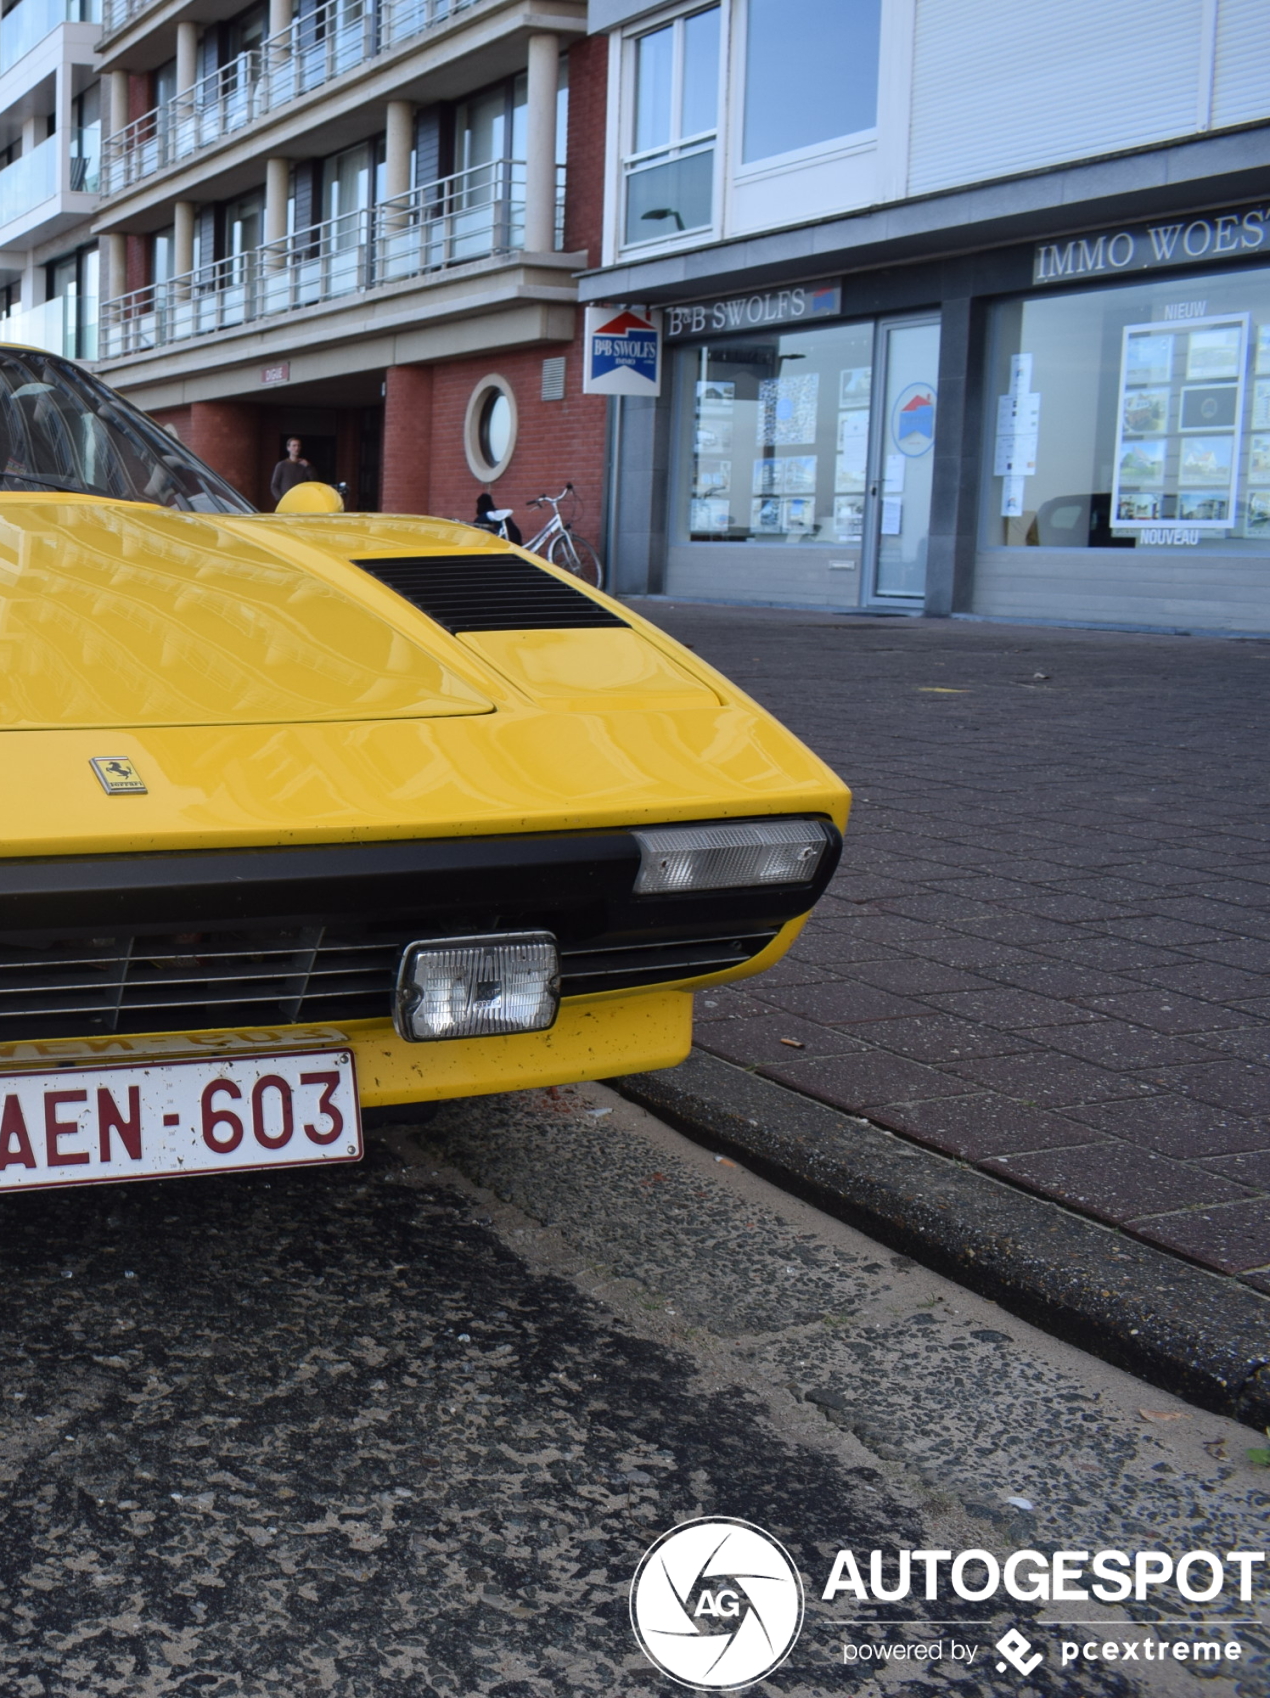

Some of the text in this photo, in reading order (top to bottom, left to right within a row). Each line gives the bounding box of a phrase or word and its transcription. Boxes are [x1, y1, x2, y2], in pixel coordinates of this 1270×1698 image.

[1036, 207, 1270, 279] IMMO WOES
[712, 288, 805, 329] SWOLFS
[1164, 301, 1207, 321] NIEUW
[613, 340, 656, 358] SWOLFS
[1140, 529, 1199, 545] NOUVEAU
